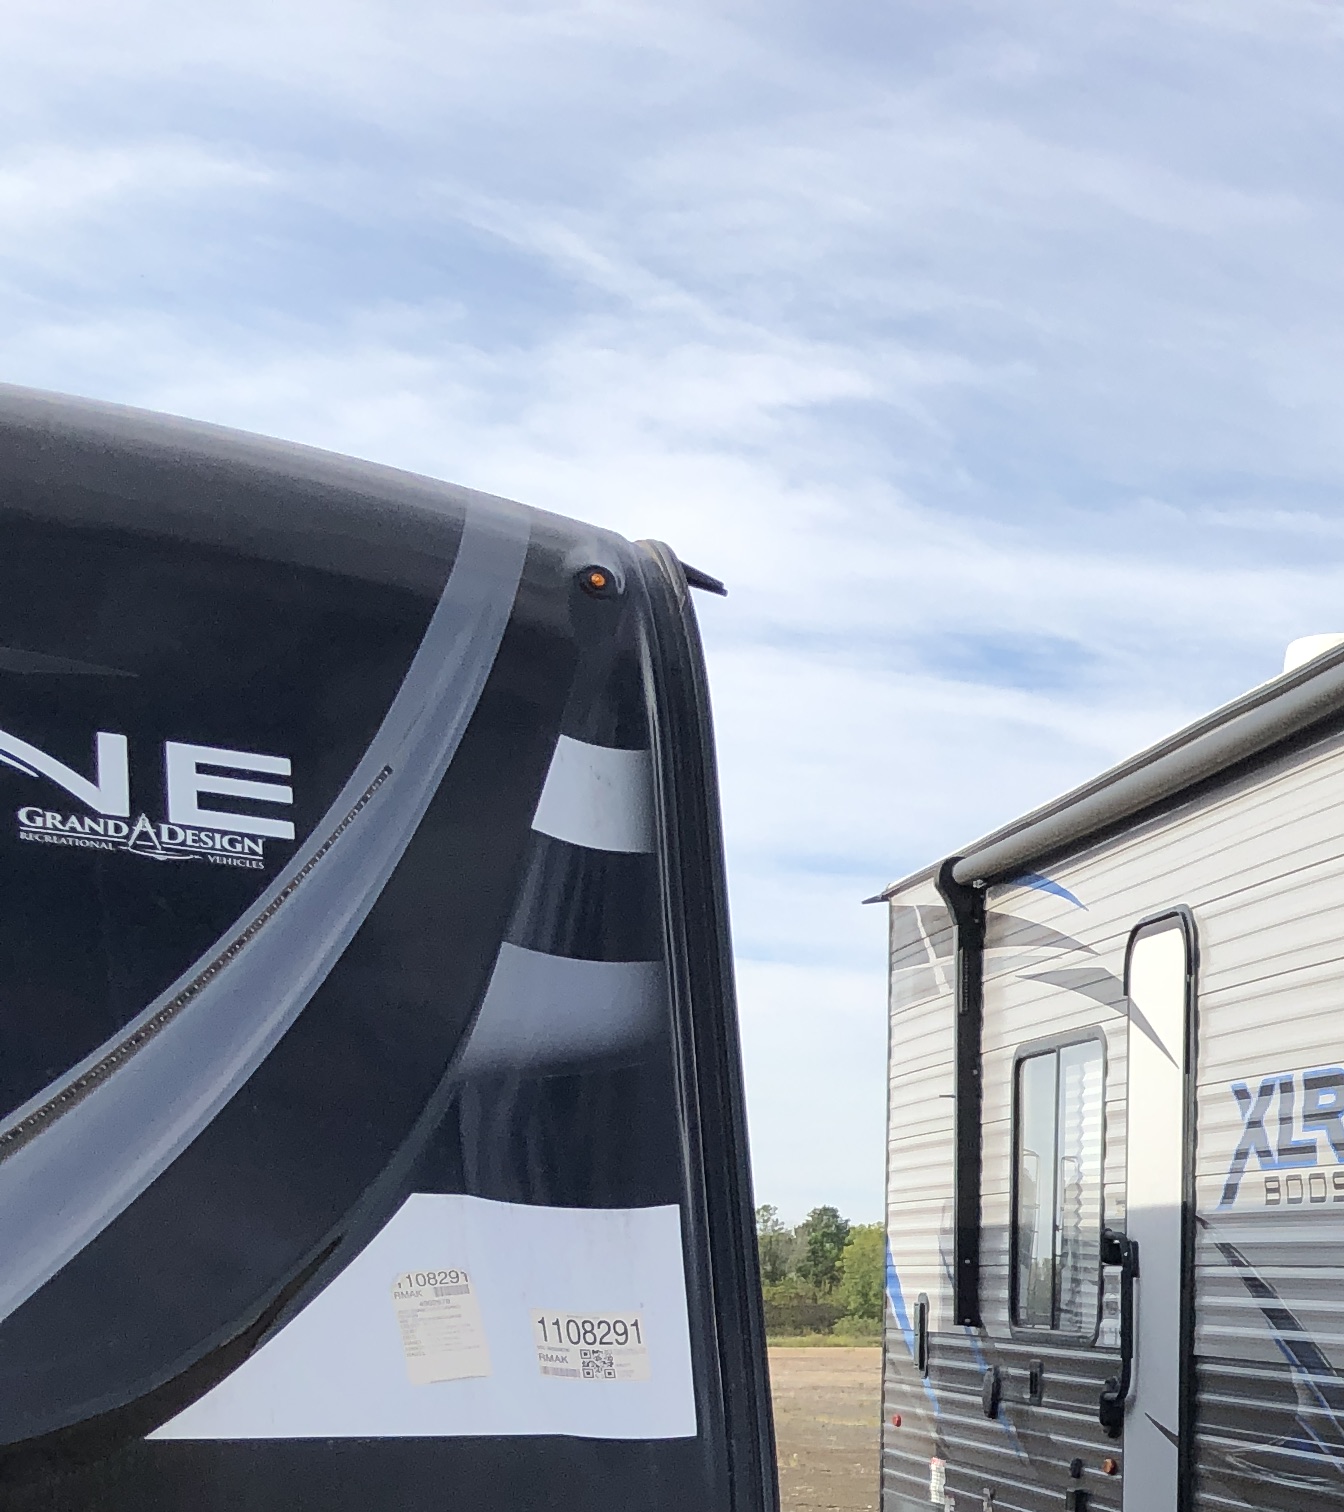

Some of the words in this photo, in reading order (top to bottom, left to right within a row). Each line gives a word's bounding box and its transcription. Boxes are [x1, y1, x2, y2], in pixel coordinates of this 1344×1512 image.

[17, 806, 130, 838] GRAND
[159, 823, 265, 855] DESIGN
[19, 832, 115, 851] RECREATIONAL
[207, 854, 265, 870] VEHICLES
[537, 1316, 642, 1346] 1108291
[538, 1352, 569, 1364] RMAK
